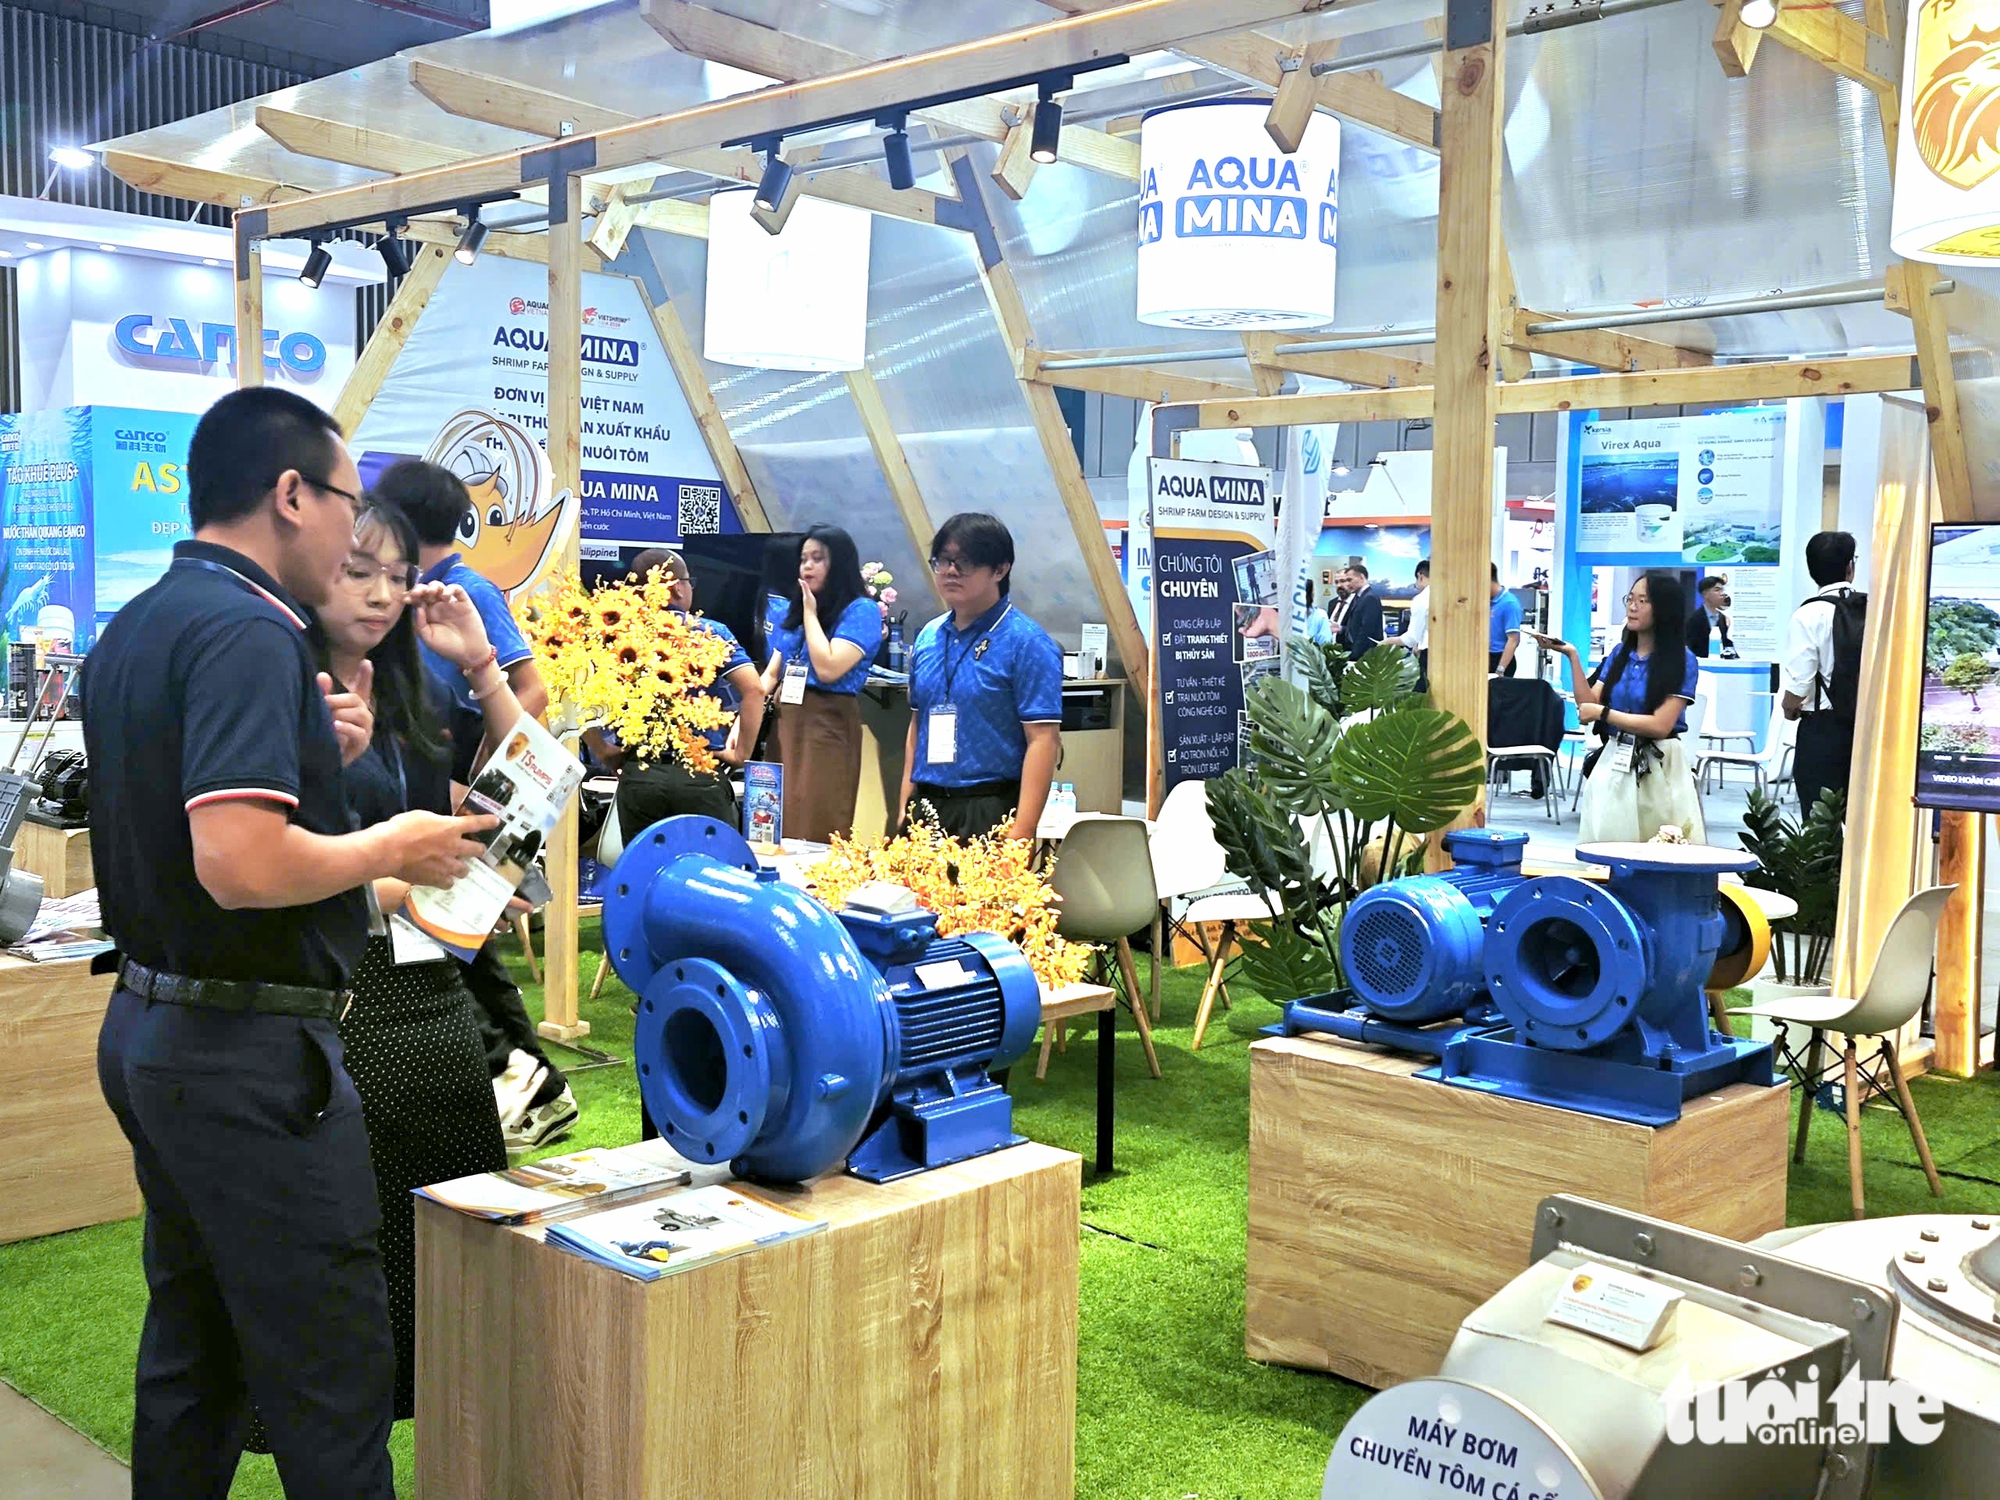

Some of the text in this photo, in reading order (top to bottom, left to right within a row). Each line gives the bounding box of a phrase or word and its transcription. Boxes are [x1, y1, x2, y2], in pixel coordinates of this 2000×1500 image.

[1187, 156, 1301, 191] AQUA
[1183, 198, 1301, 236] MINA
[493, 326, 549, 352] AQU
[492, 356, 529, 369] SHRIMP
[605, 371, 638, 382] SUPPLY
[494, 386, 644, 415] ĐƠN VỊ VIỆT NAM
[114, 430, 166, 442] CANCO
[597, 421, 631, 438] XUẤT
[634, 424, 670, 442] KHẨU
[486, 437, 649, 463] TH NUÔI TÔM
[1601, 440, 1661, 450] Virex Aqua
[50, 462, 79, 482] PLUS+
[131, 460, 188, 494] AS
[610, 483, 660, 502] MINA
[1158, 475, 1262, 502] AQUA MINA
[624, 510, 642, 520] Minh,
[656, 512, 672, 520] Nam
[1158, 506, 1266, 522] SHRIMP FARM DESIGN & SUPPLY
[152, 521, 181, 538] ĐẸP
[1159, 552, 1222, 574] CHÚNG TÔI
[1160, 578, 1219, 598] CHUYÊN
[1174, 619, 1192, 629] CUNG
[1205, 619, 1210, 628] &
[1187, 634, 1210, 644] TRANG
[1210, 632, 1228, 644] THIẾT
[1175, 648, 1215, 662] BỊ THỦY SẢN
[1176, 690, 1220, 704] TRẠI NUÔI TÔM
[1178, 706, 1196, 718] CÔNG
[1214, 706, 1227, 715] CAO
[1192, 732, 1207, 744] XUẤT
[521, 750, 536, 767] TS
[1180, 750, 1189, 760] AO
[1932, 774, 1958, 784] VIDEO
[1408, 1416, 1518, 1468] MÁY BƠM
[1350, 1436, 1520, 1500] CHUYỂN TÔM CÁ
